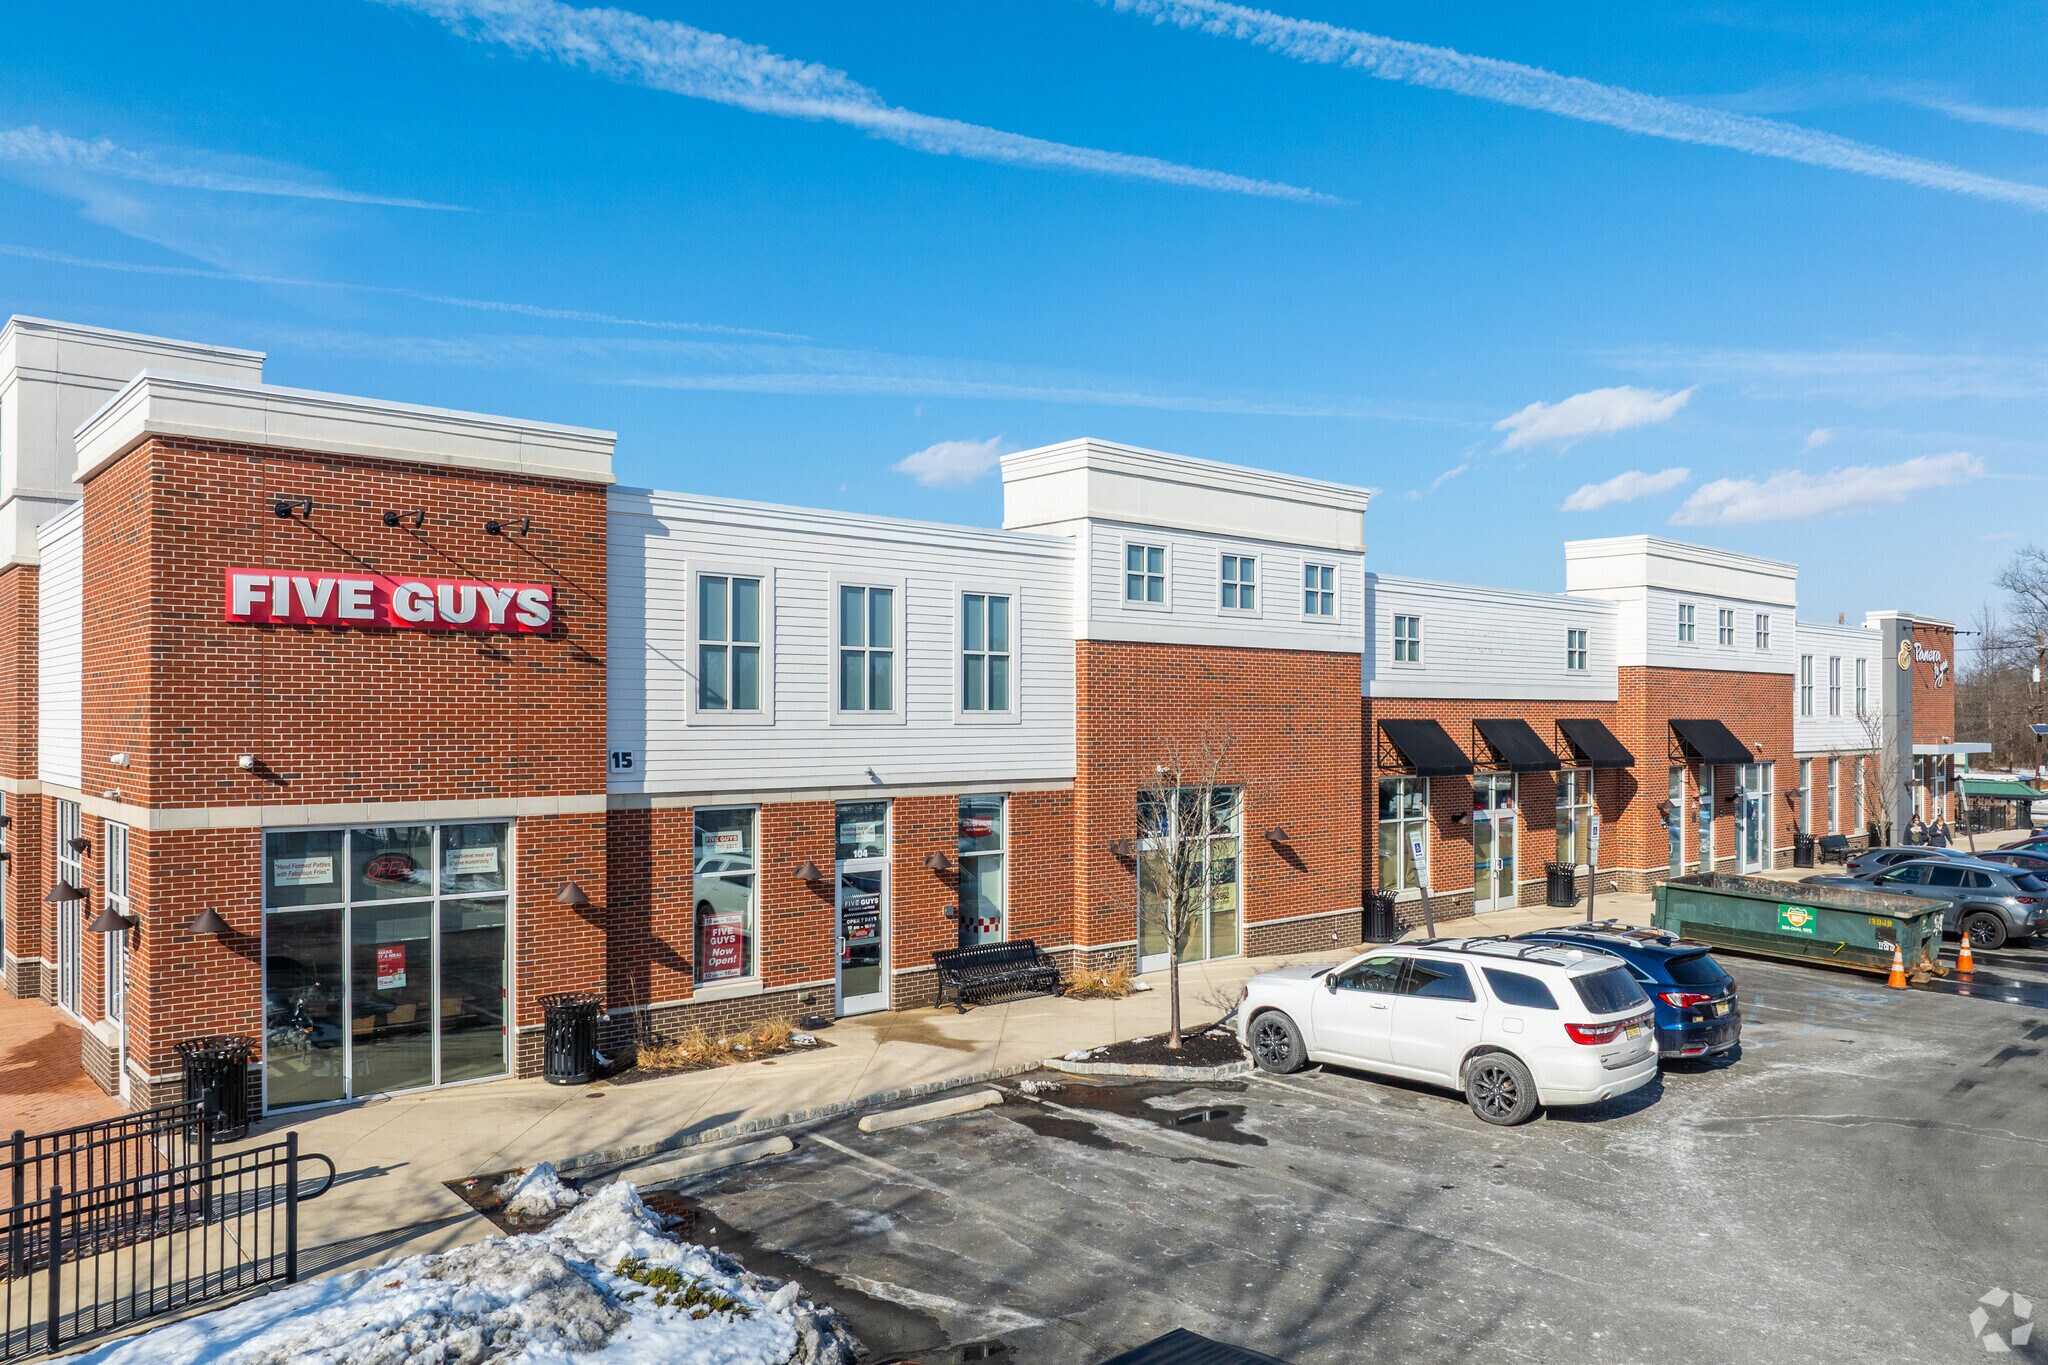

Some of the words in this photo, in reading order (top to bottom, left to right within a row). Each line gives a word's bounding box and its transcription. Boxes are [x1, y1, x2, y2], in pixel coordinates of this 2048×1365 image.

[233, 574, 375, 620] FIVE
[392, 582, 550, 627] GUYS
[1913, 642, 1941, 662] Panera
[612, 752, 633, 768] 15
[853, 849, 868, 858] 104
[367, 861, 411, 877] OPEN
[860, 897, 879, 905] GUYS
[712, 927, 734, 936] FIVE
[710, 935, 736, 945] GUYS
[712, 948, 734, 957] Now
[708, 955, 737, 967] Open!
